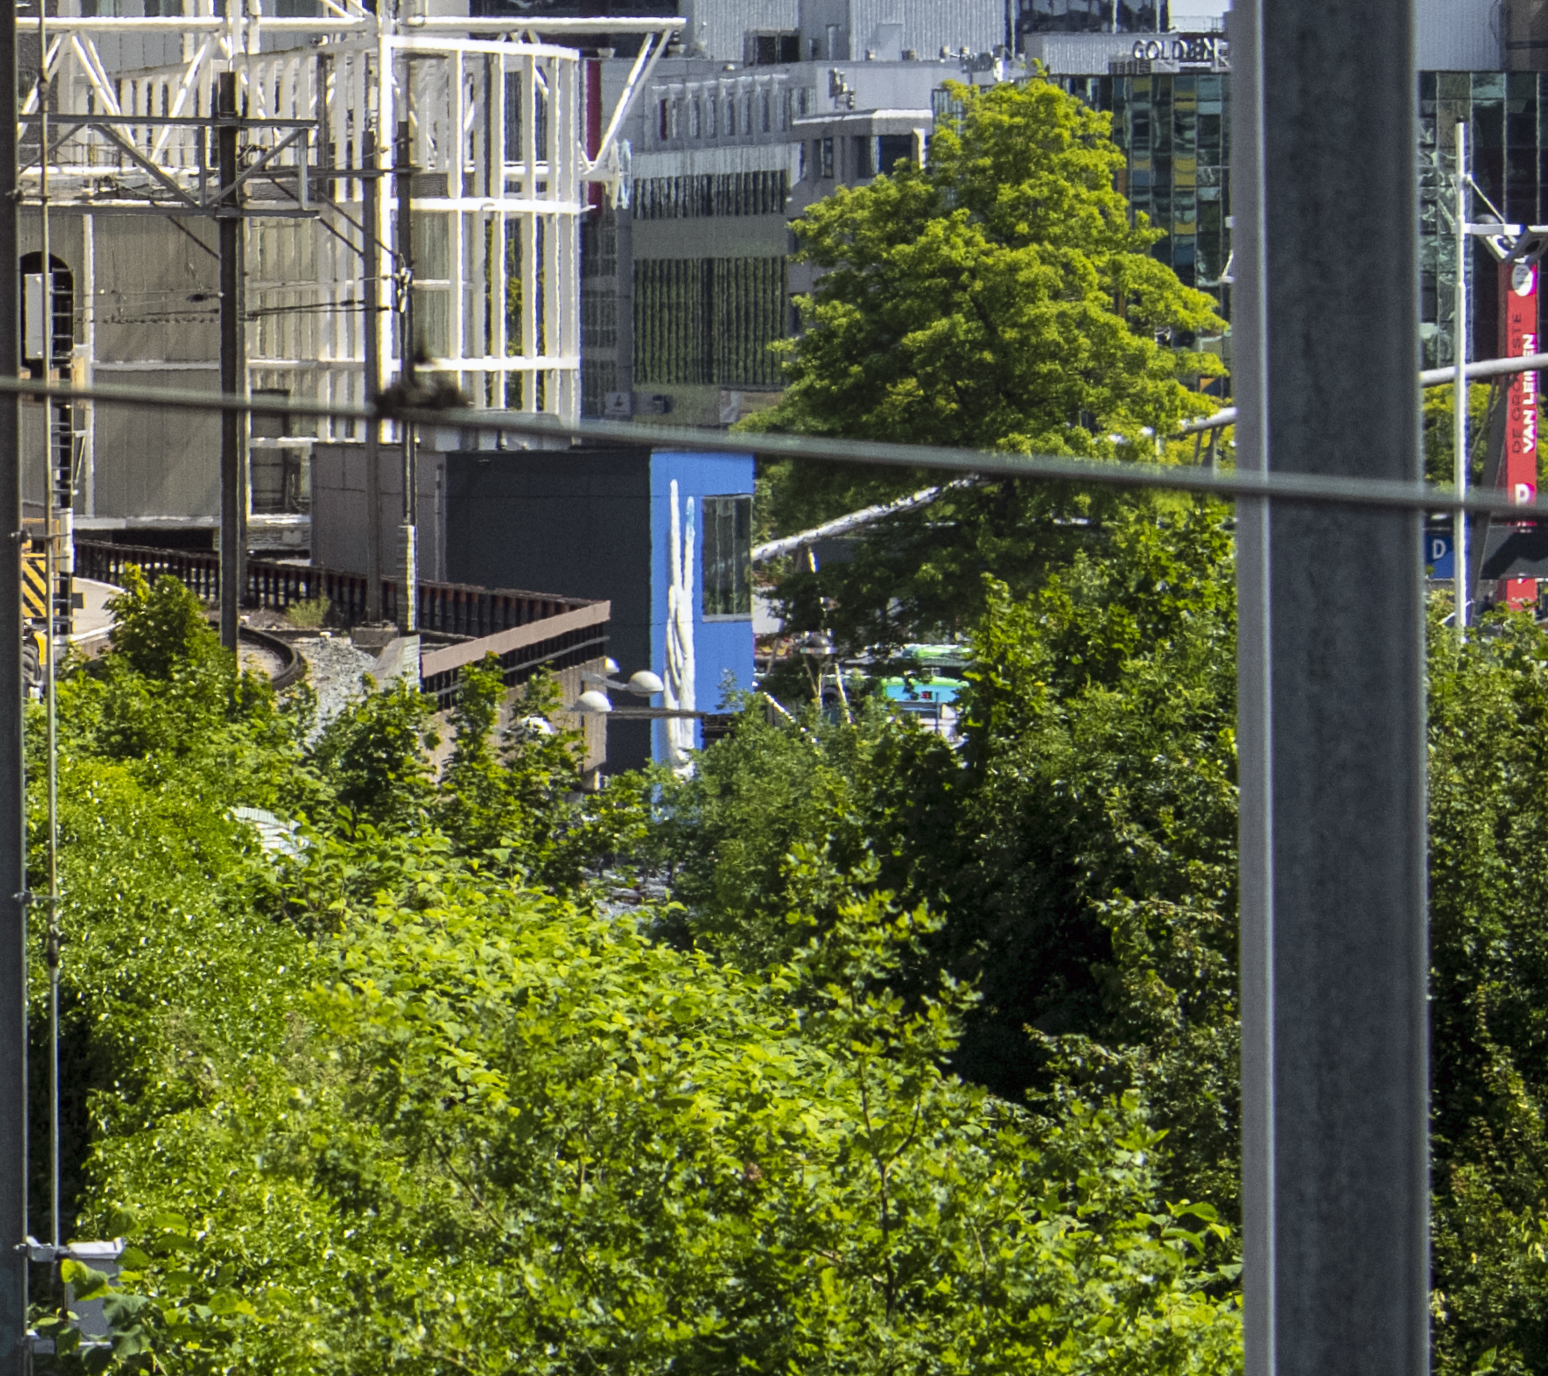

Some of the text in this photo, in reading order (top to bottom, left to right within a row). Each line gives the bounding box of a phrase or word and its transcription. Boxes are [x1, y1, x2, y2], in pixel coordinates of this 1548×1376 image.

[1512, 312, 1522, 422] GROTSTE
[1522, 332, 1536, 454] VAN LEIEN
[1433, 539, 1446, 559] D
